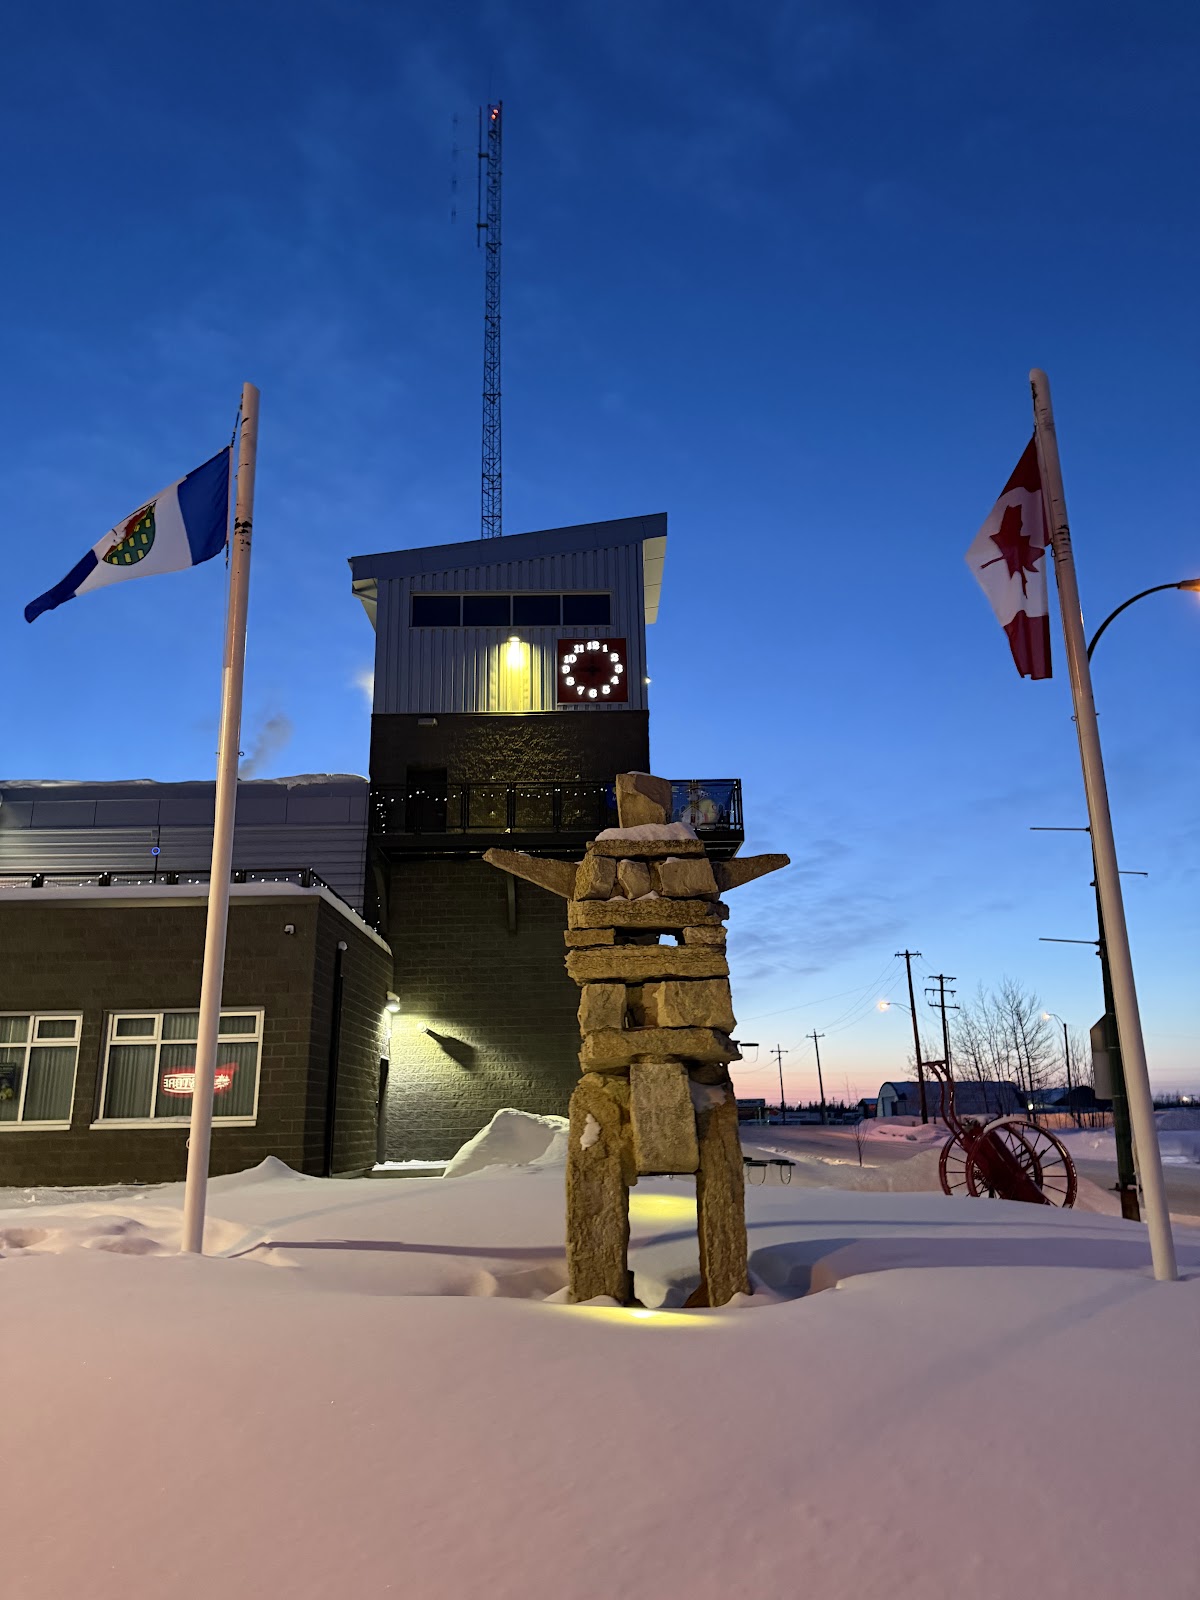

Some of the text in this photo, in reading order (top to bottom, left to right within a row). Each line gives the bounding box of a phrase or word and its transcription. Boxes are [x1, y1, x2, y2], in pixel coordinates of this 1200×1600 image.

[574, 644, 584, 654] 11
[587, 641, 600, 650] 12
[602, 644, 608, 652] 1
[564, 654, 577, 663] 10
[610, 653, 619, 662] 2
[562, 665, 570, 674] 9
[614, 664, 623, 674] 3
[566, 676, 575, 686] 8
[610, 676, 619, 684] 4
[577, 686, 585, 695] 7
[588, 689, 597, 698] 6
[602, 685, 610, 694] 5
